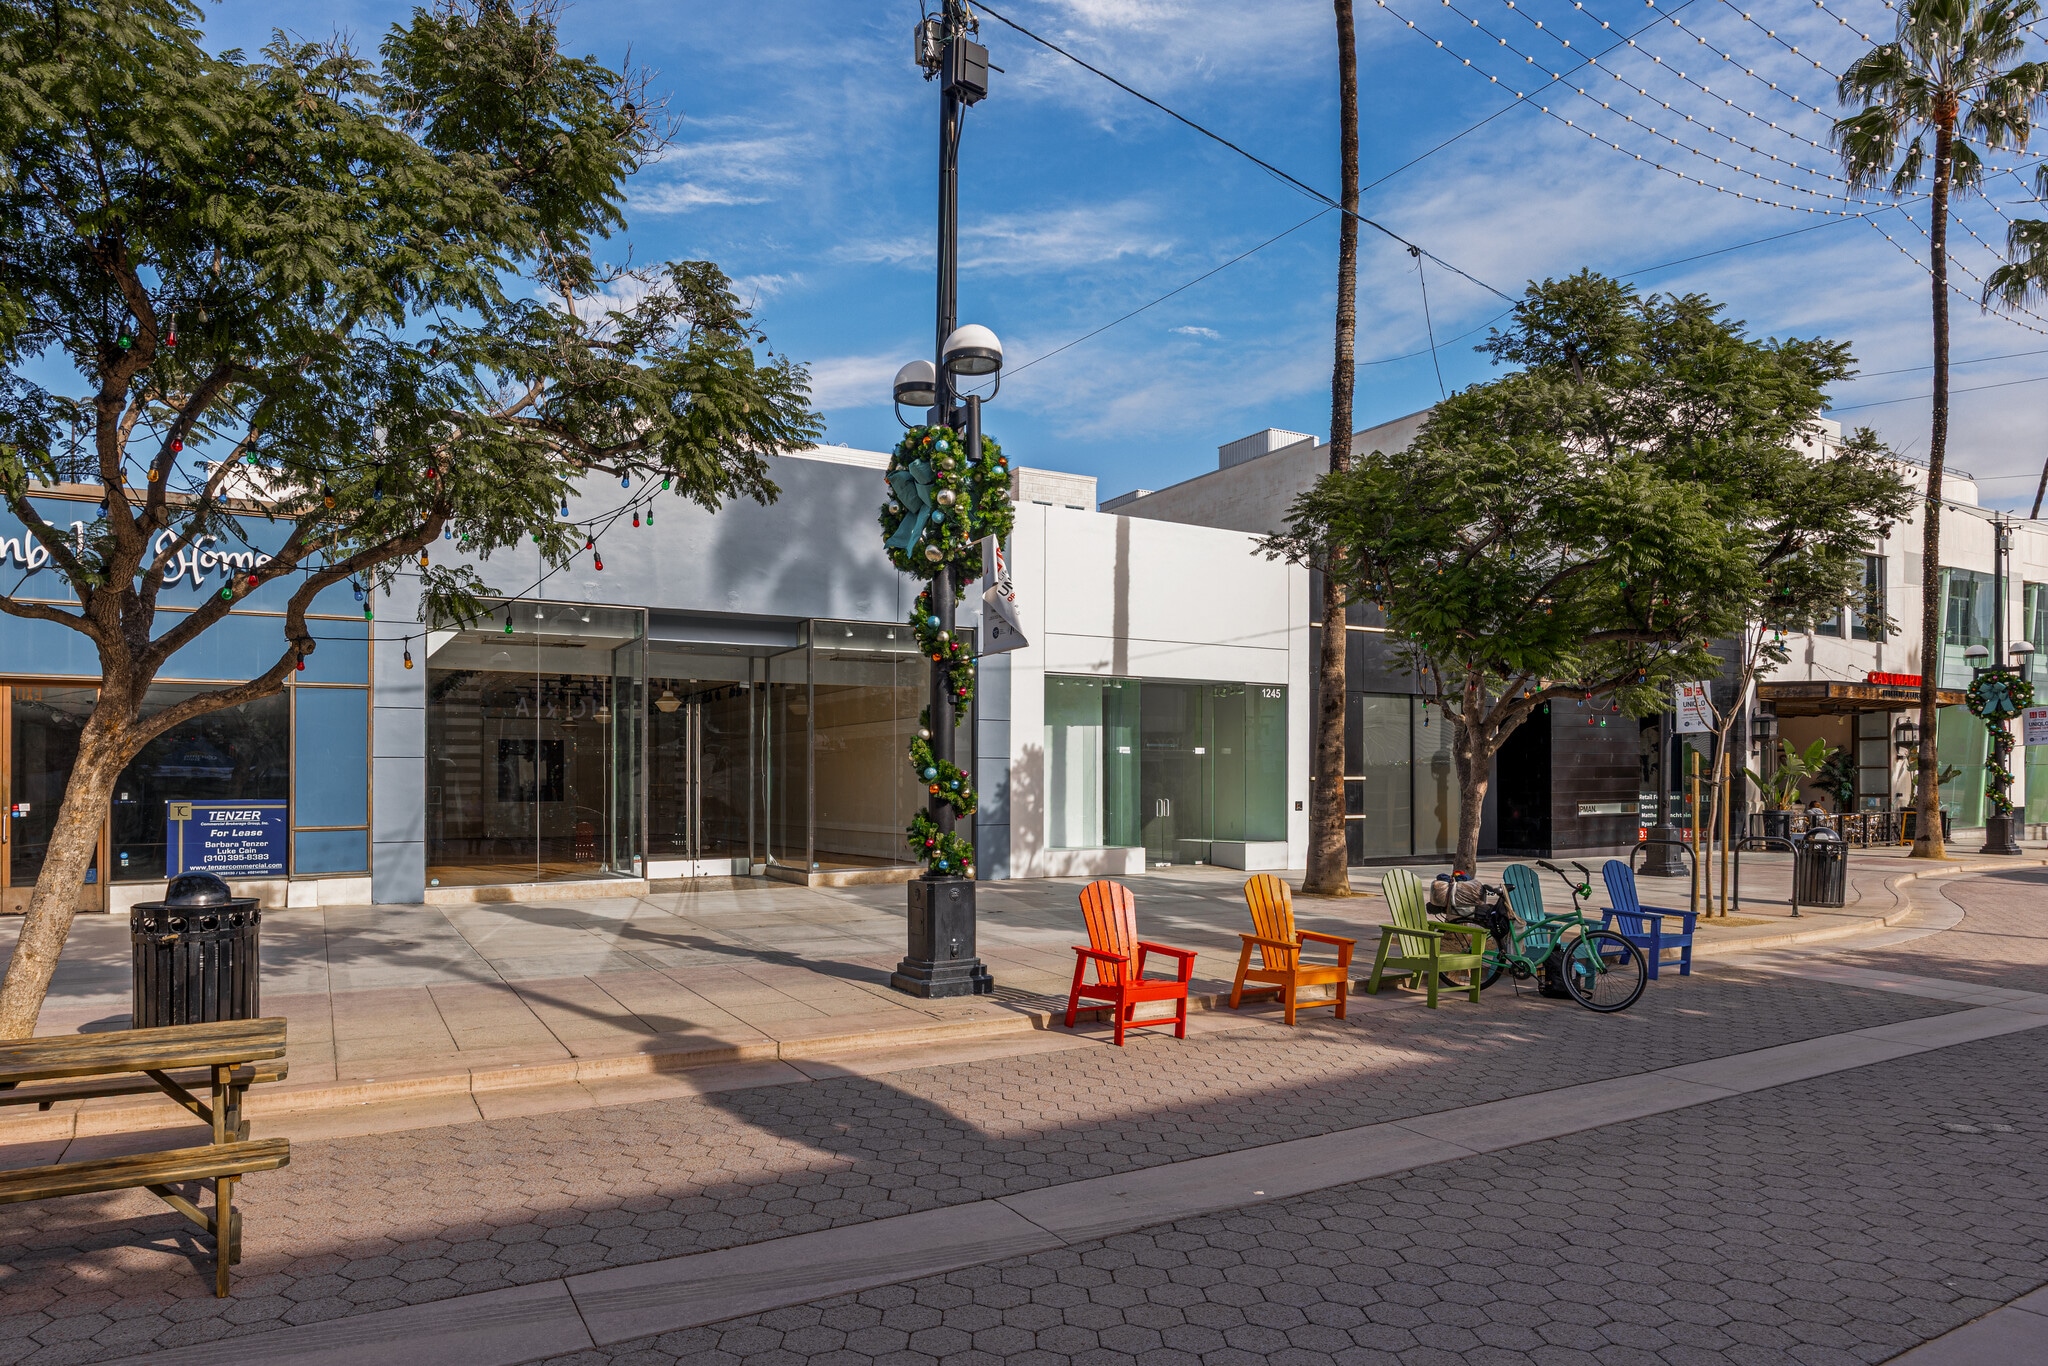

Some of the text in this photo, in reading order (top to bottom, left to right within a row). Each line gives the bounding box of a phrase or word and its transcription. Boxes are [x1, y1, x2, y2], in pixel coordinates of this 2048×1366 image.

[1262, 688, 1281, 699] 1245
[208, 810, 262, 821] TENZER
[210, 828, 264, 837] For Lease
[203, 853, 270, 863] (310) 395-8383
[189, 863, 283, 871] www.tenzercommercial.com
